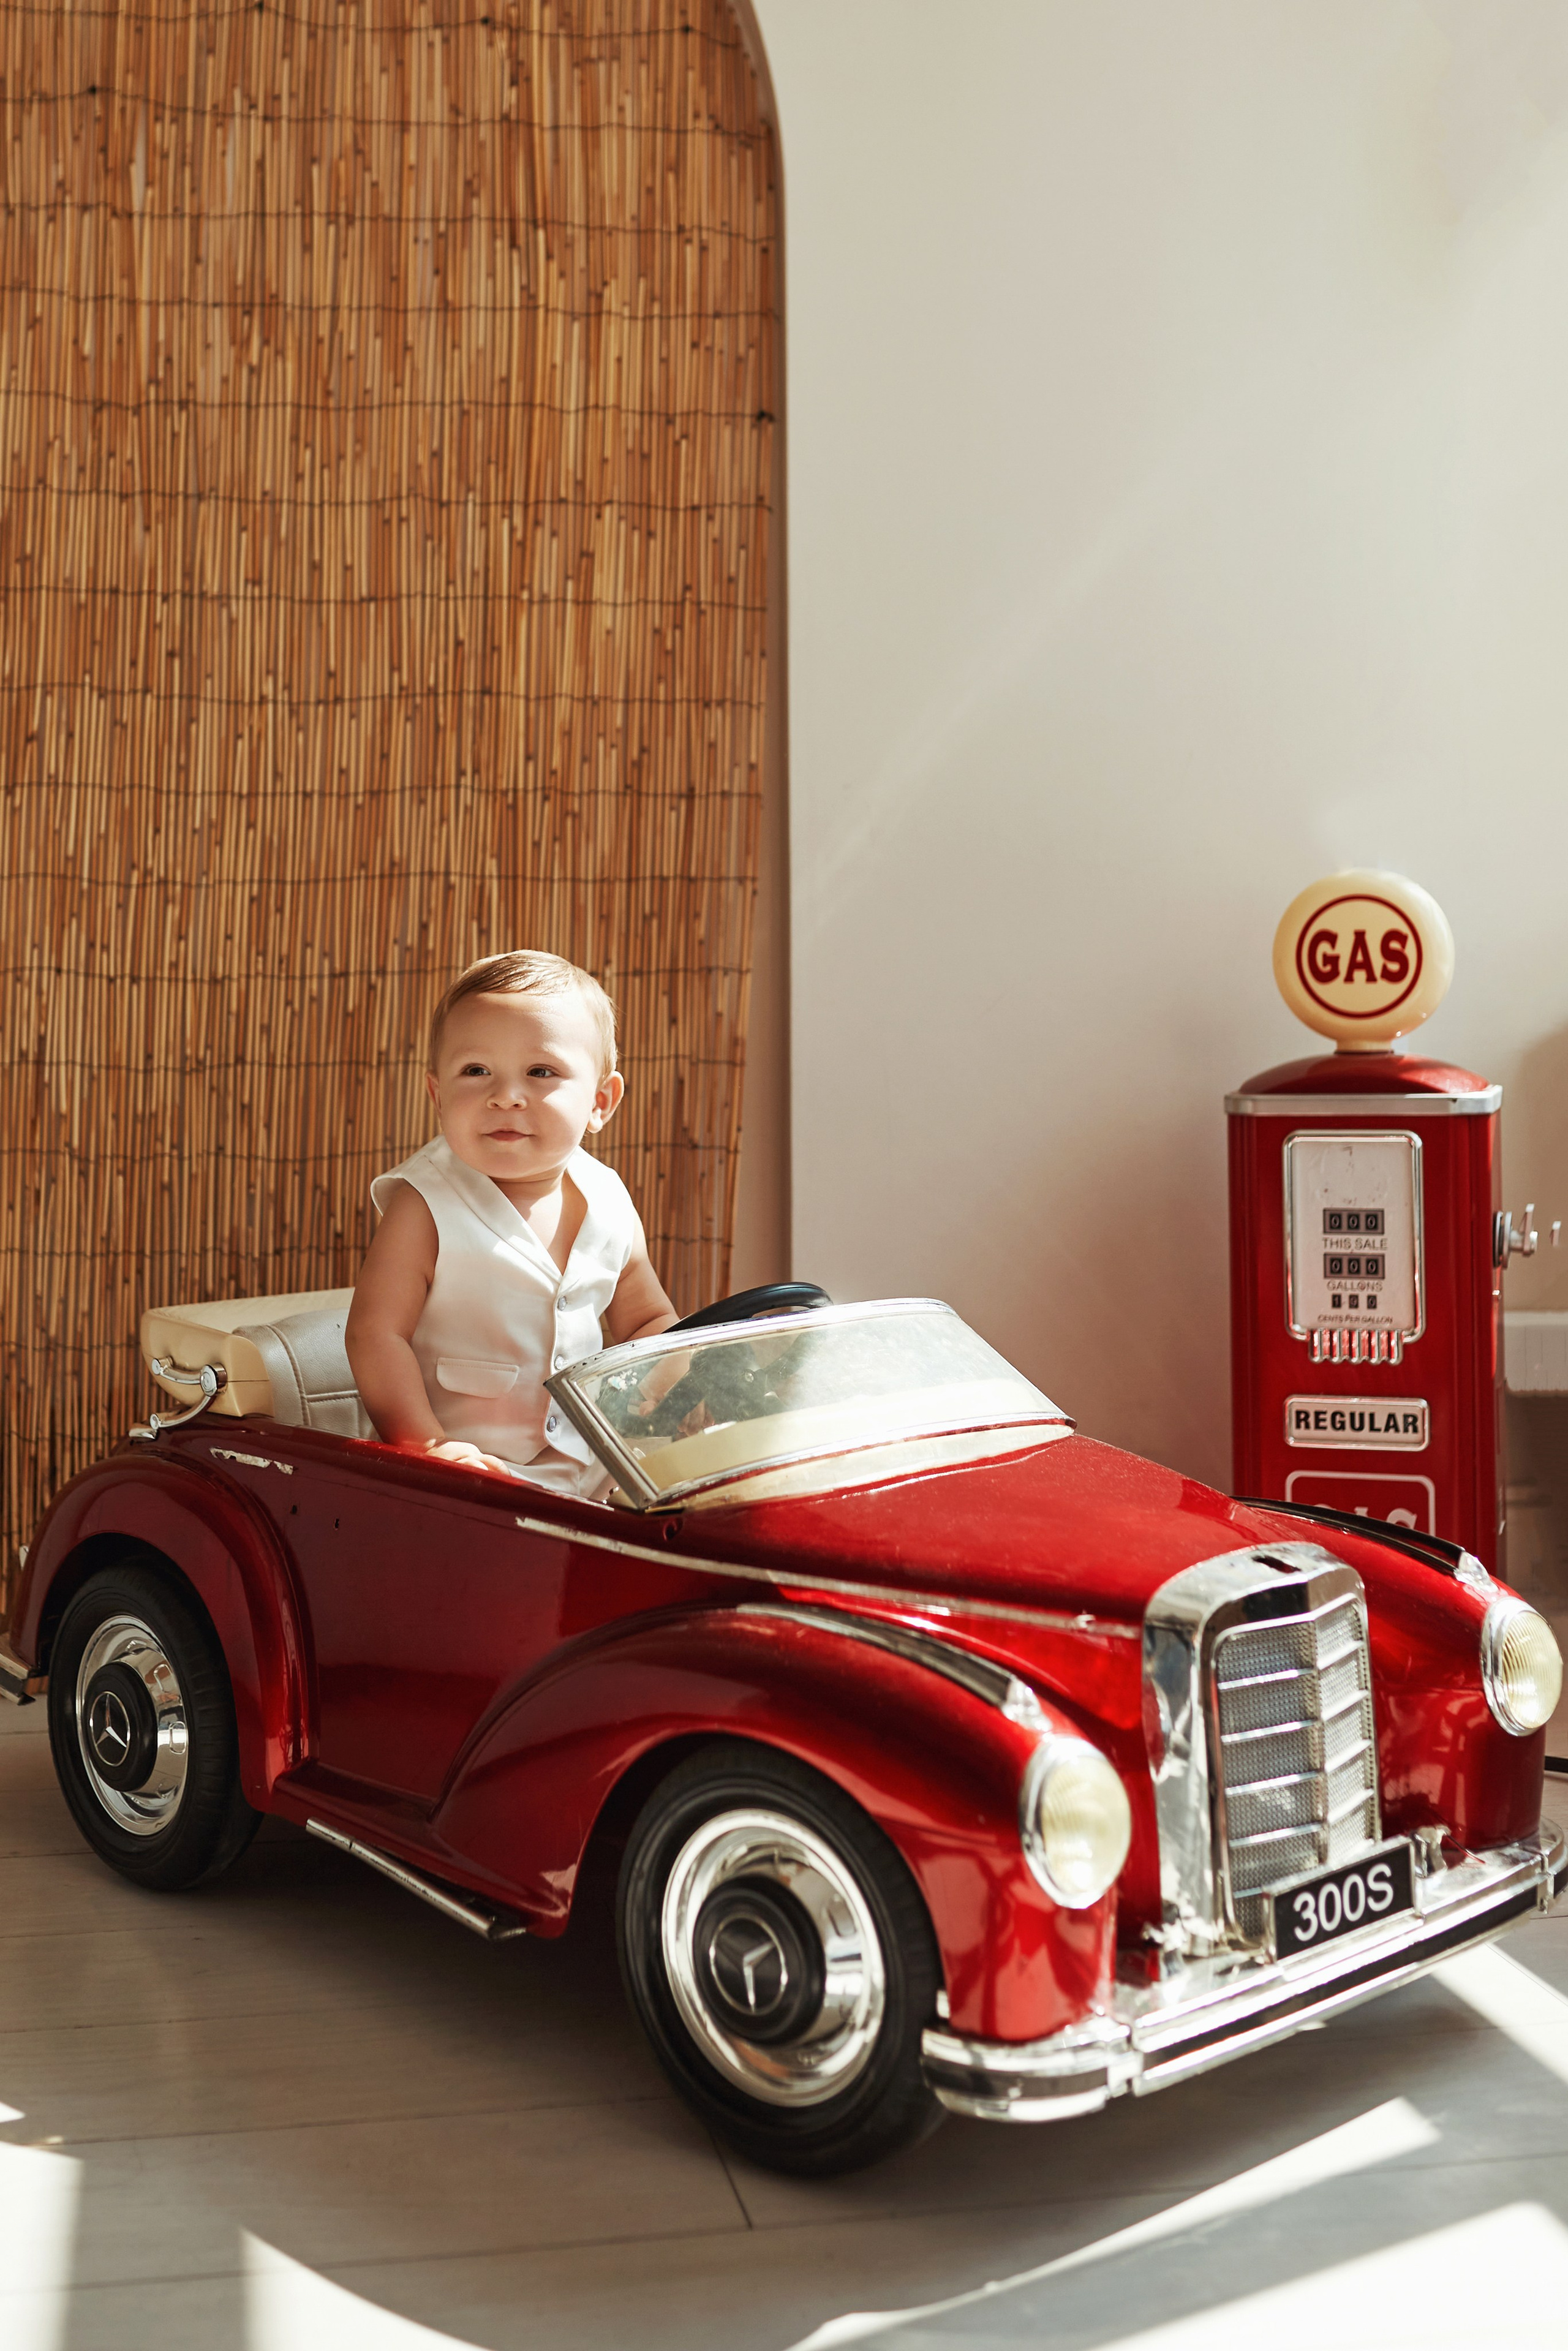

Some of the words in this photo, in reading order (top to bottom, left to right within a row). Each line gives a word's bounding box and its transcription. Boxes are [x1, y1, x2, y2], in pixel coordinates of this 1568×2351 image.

[1307, 928, 1410, 984] GAS
[1322, 1237, 1351, 1250] THIS
[1355, 1237, 1388, 1250] SALE
[1327, 1280, 1382, 1292] GALLONS
[1362, 1315, 1393, 1324] GALLON
[1295, 1410, 1419, 1434] REGULAR
[1293, 1863, 1393, 1941] 300S
